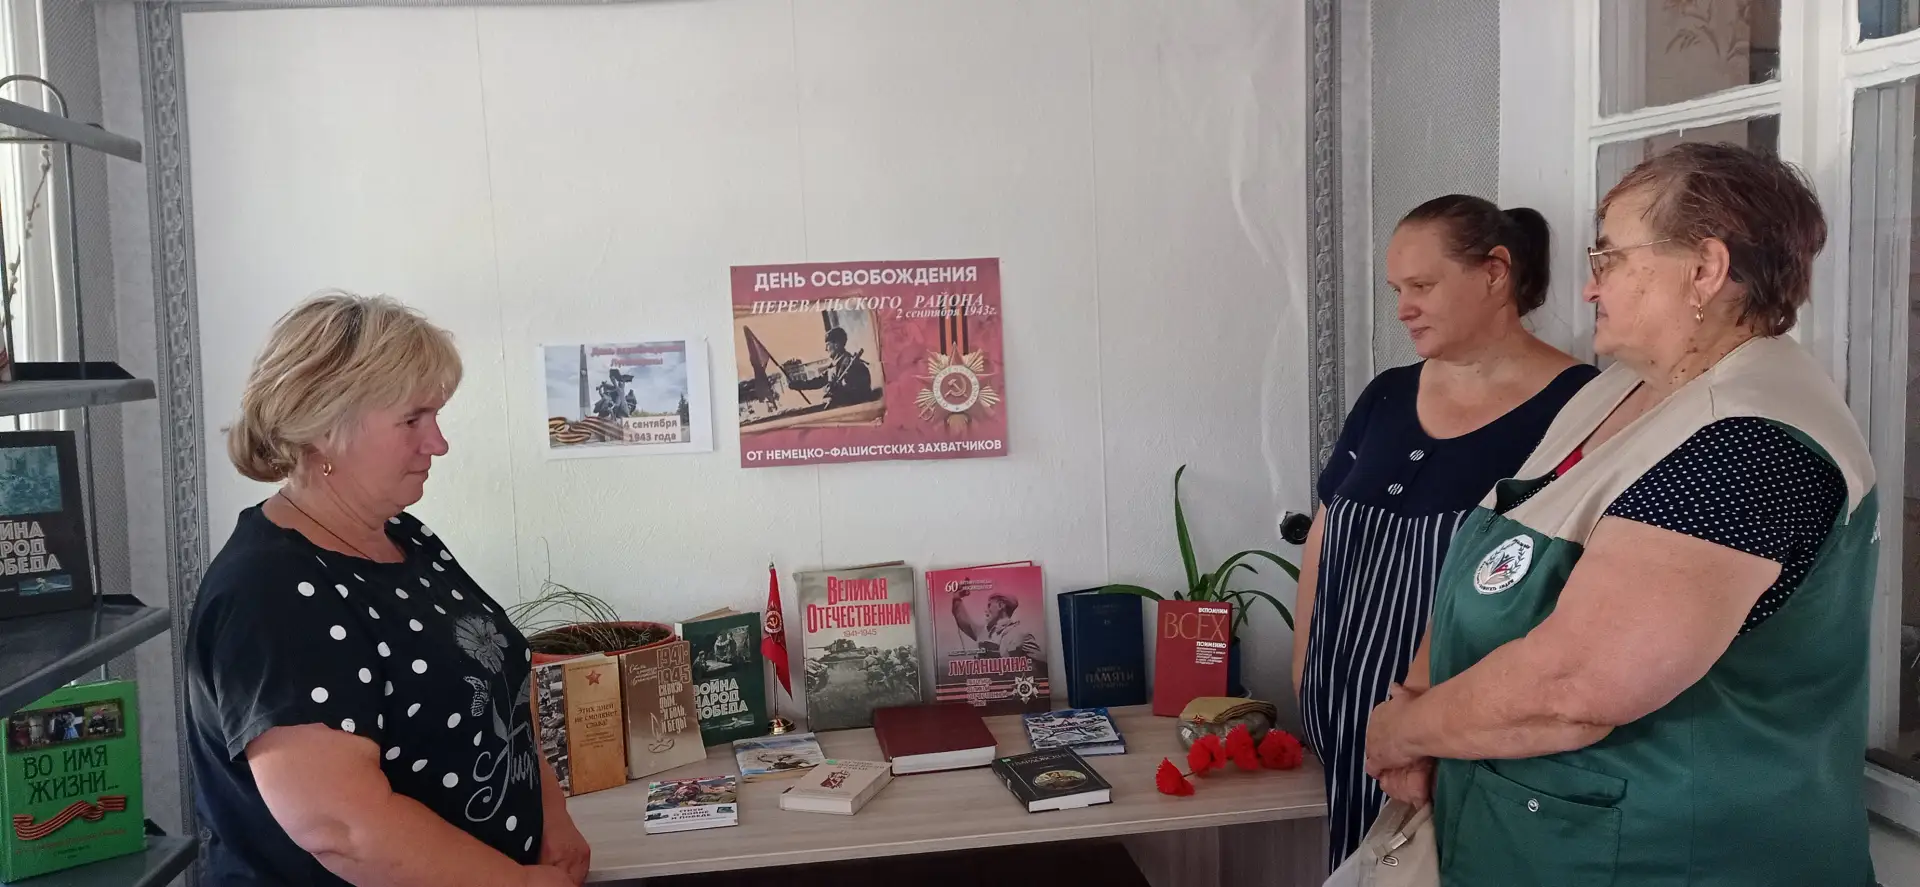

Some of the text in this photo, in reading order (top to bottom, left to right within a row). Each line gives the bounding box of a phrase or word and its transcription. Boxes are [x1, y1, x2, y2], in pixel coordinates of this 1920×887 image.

[754, 266, 977, 291] ДЕНЬ ОСВОБОЖДЕНИЯ
[751, 291, 984, 315] ПЕРЕВАЛЬСКОГО РАЙОНА
[895, 309, 904, 319] 2
[905, 306, 961, 318] сентября
[632, 418, 678, 430] сентября
[629, 432, 677, 442] 1943 года
[746, 439, 1002, 461] ОТ НЕМЕЦКО-ФАШИСТСКИХ ЗАХВАТЧИКОВ
[827, 576, 888, 605] ВЕЛИКАЯ
[945, 580, 959, 593] 60
[806, 602, 911, 634] ОТЕЧЕСТВЕННАЯ
[1164, 612, 1226, 641] ВСЕХ
[843, 628, 877, 637] 1941-1945
[658, 664, 690, 686] 1945
[948, 656, 1032, 677] ЛУГАНЩИНА:
[23, 744, 109, 780] ВО ИМЯ
